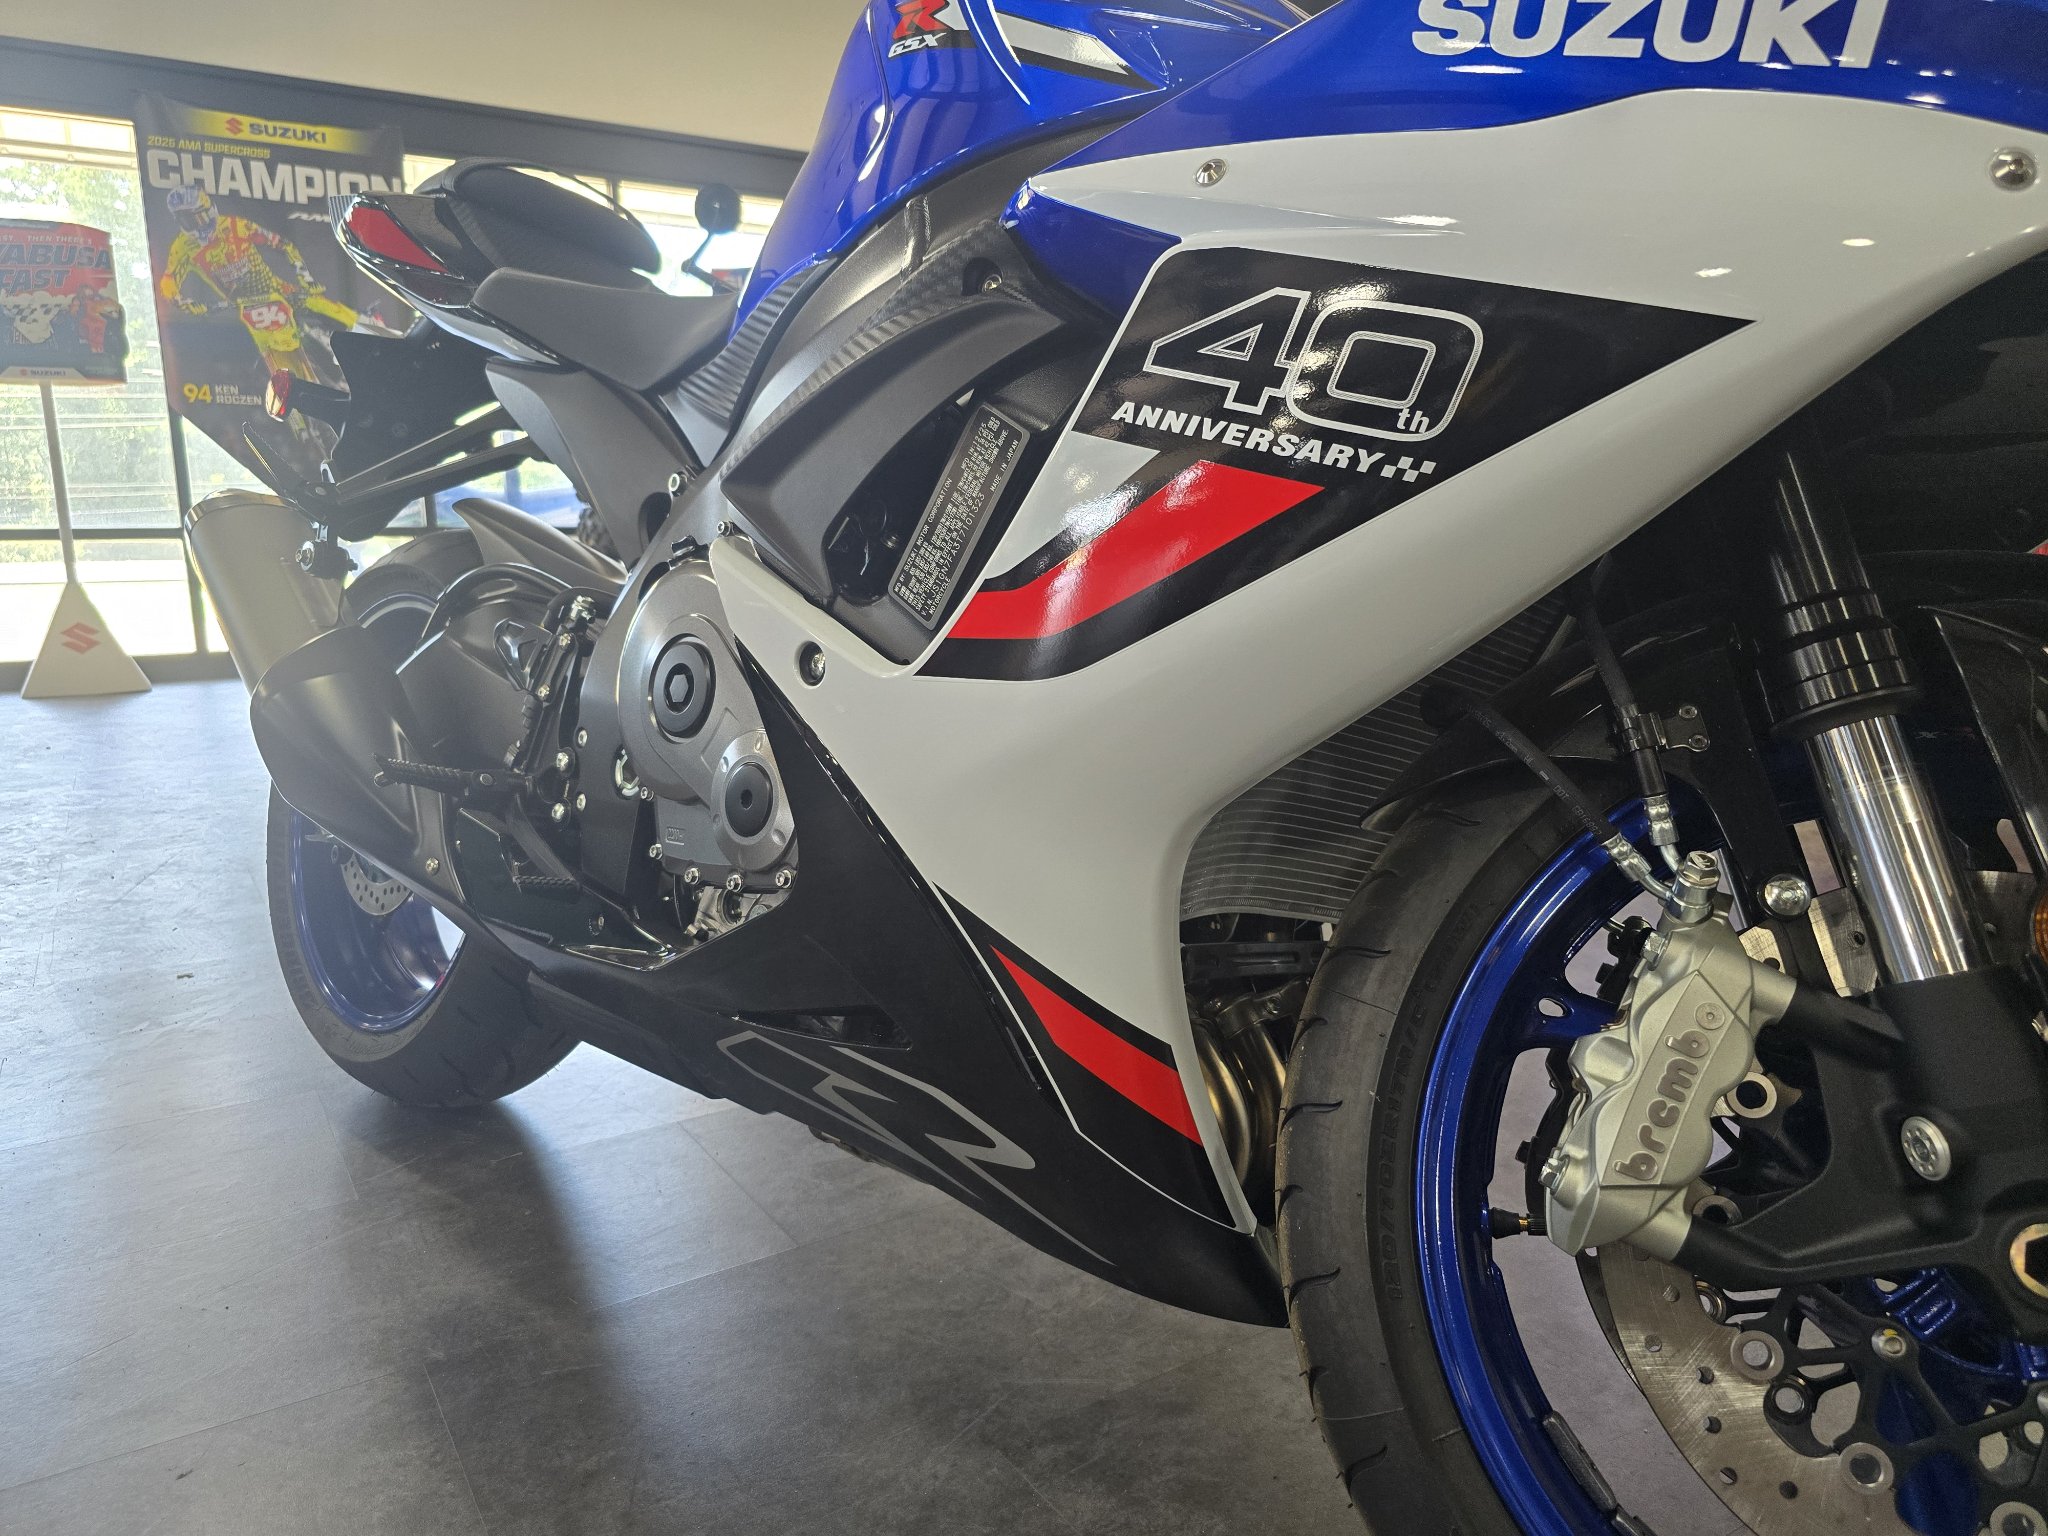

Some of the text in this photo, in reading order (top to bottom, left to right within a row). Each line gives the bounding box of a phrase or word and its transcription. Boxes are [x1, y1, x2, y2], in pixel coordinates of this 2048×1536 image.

[888, 32, 947, 58] GSX
[1412, 0, 1887, 68] SUZUKI
[178, 139, 202, 151] AMA
[204, 142, 271, 159] SUPERCROSS
[249, 122, 327, 144] SUZUKI
[251, 304, 287, 329] 94
[1143, 286, 1484, 442] 40 th
[183, 383, 211, 404] 94
[215, 384, 239, 395] KEN
[1110, 401, 1386, 475] ANNIVERSARY
[989, 438, 1019, 492] MADE IN JAPAN
[902, 547, 918, 572] SUZUKI
[915, 523, 930, 546] MOTOR
[926, 476, 953, 523] CORPORATION
[928, 575, 951, 615] MOTORCYCLE
[1612, 1001, 1726, 1181] brembo
